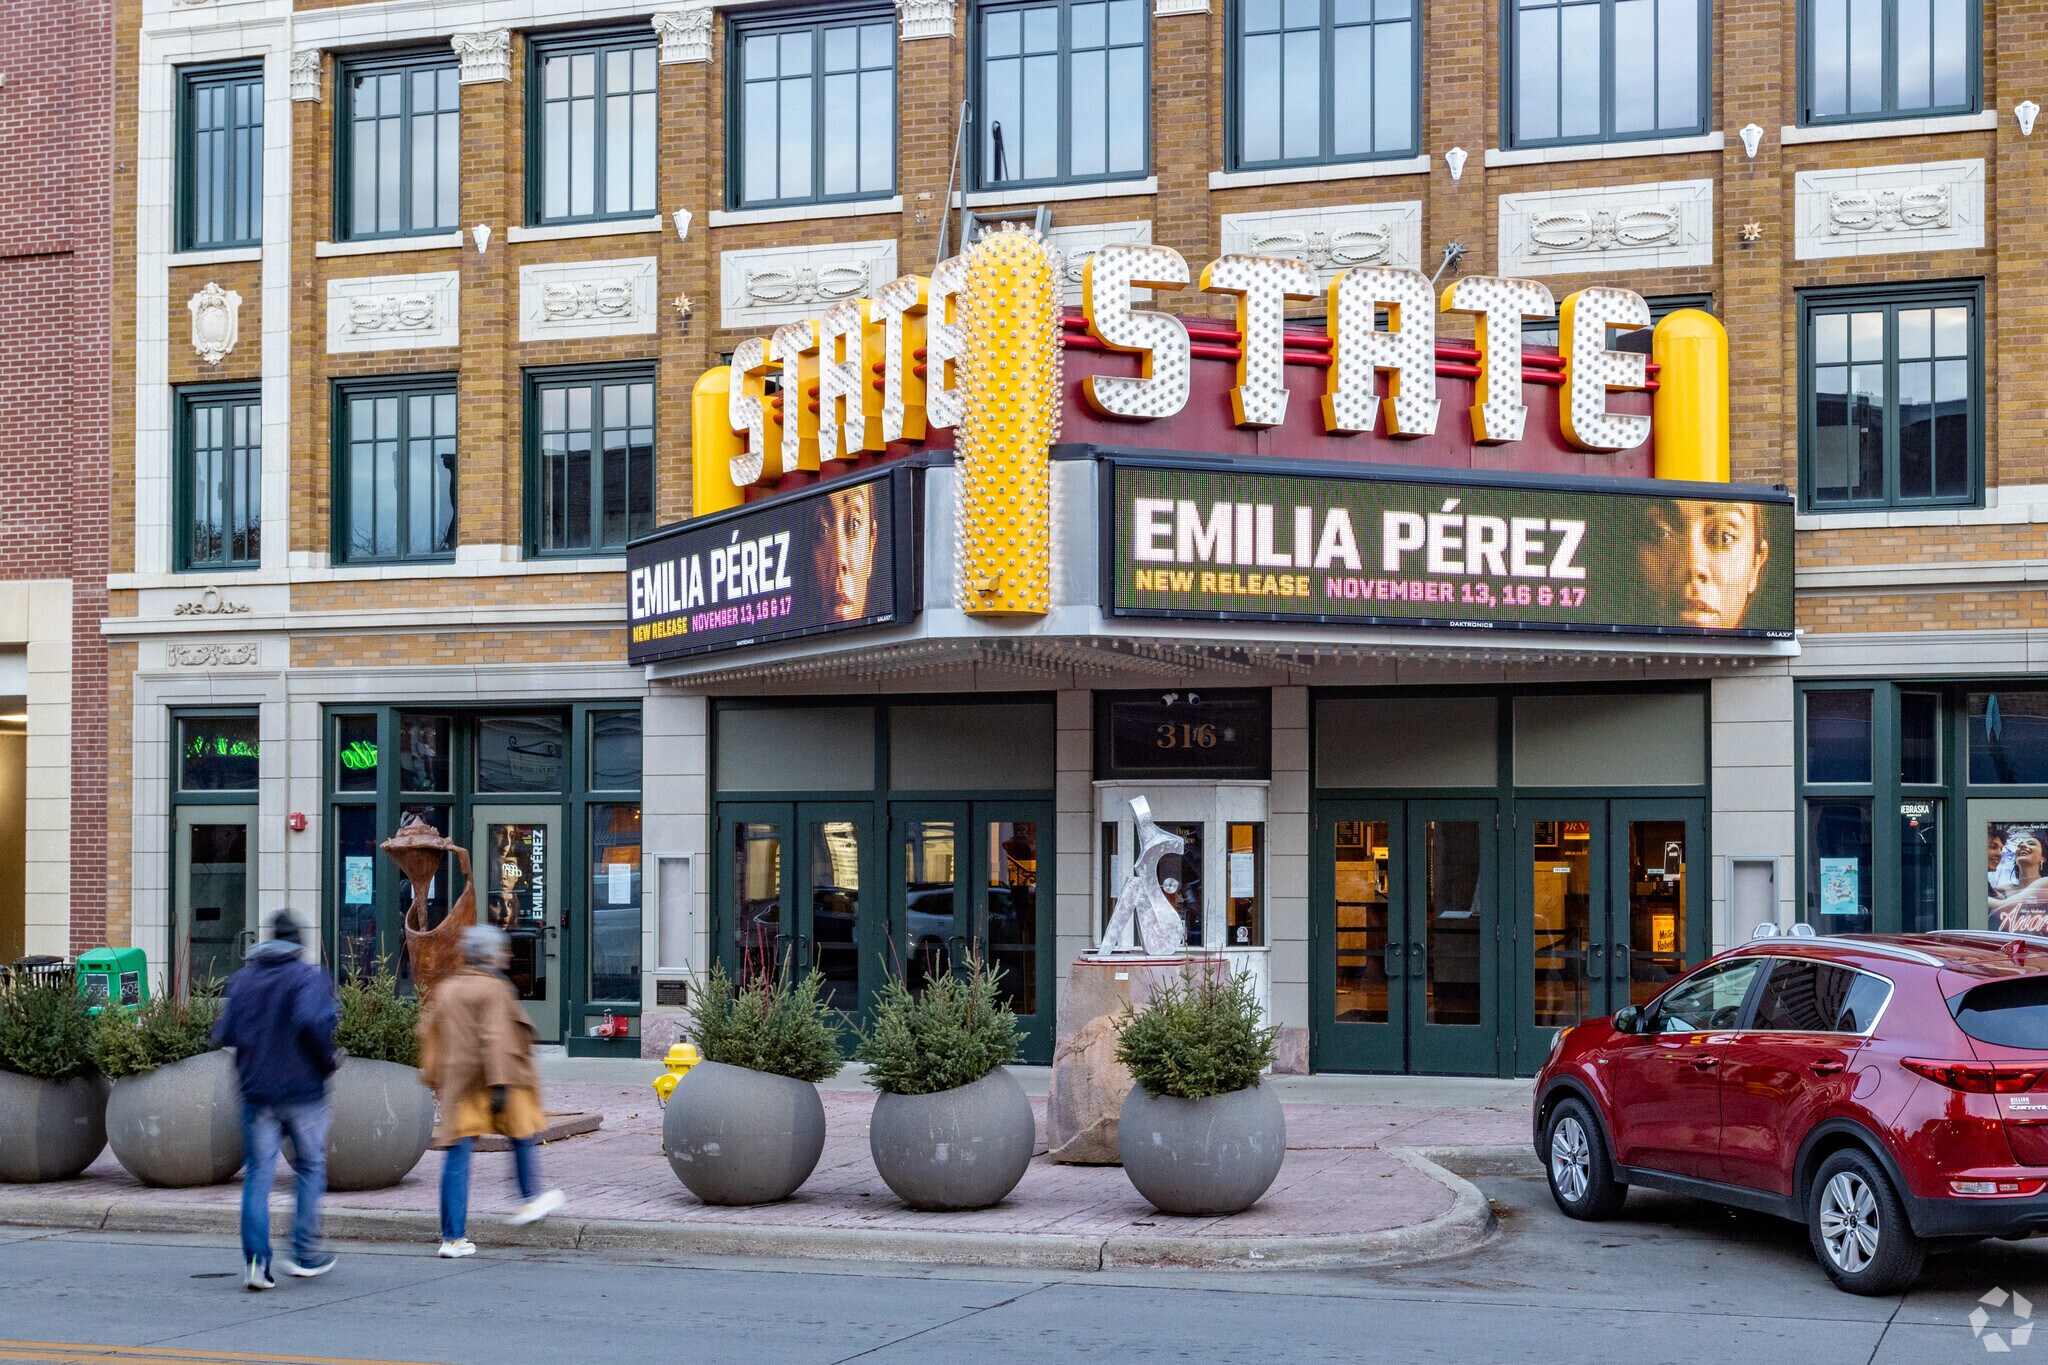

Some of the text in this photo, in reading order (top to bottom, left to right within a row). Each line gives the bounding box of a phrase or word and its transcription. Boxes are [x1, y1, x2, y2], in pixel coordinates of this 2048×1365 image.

[1083, 243, 1651, 452] STATE
[1134, 497, 1588, 580] EMILIA PÉREZ
[632, 529, 792, 620] EMILIA PÉREZ
[1135, 570, 1587, 609] NEW RELEASE NOVEMBER 13, 16 & 17
[633, 595, 792, 643] NEW RELEASE NOVEMBER 13, 16 & 17
[1156, 723, 1217, 749] 316
[530, 829, 543, 873] PÉREZ
[1175, 827, 1191, 836] Box
[532, 875, 543, 919] EMILIA
